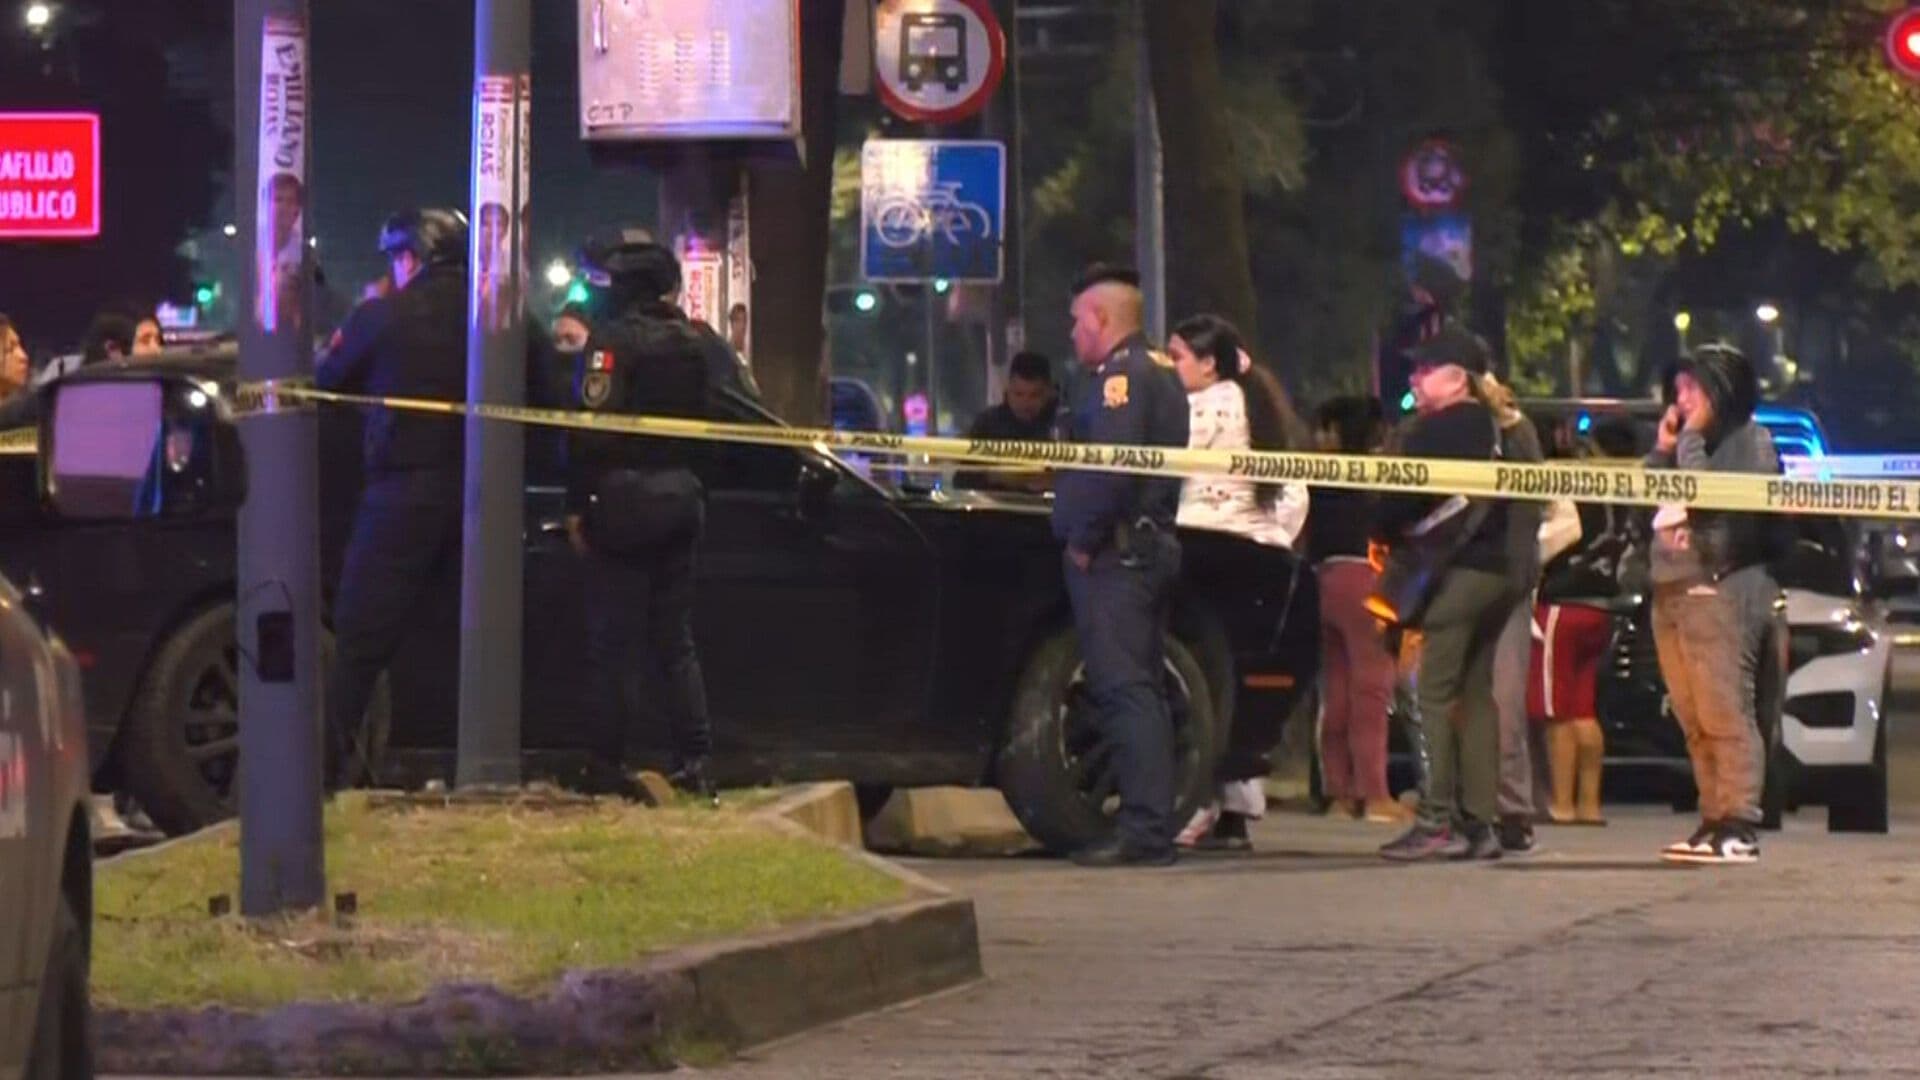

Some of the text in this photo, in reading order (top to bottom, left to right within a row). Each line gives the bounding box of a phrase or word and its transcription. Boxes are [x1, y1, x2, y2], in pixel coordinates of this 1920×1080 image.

[0, 151, 75, 180] AFLUJO
[1109, 447, 1166, 470] PASO
[1228, 453, 1430, 487] PROHIBIDO EL PASO
[1495, 466, 1698, 501] PROHIBIDO EL PASO
[1766, 480, 1910, 512] PROHIBIDO EL
